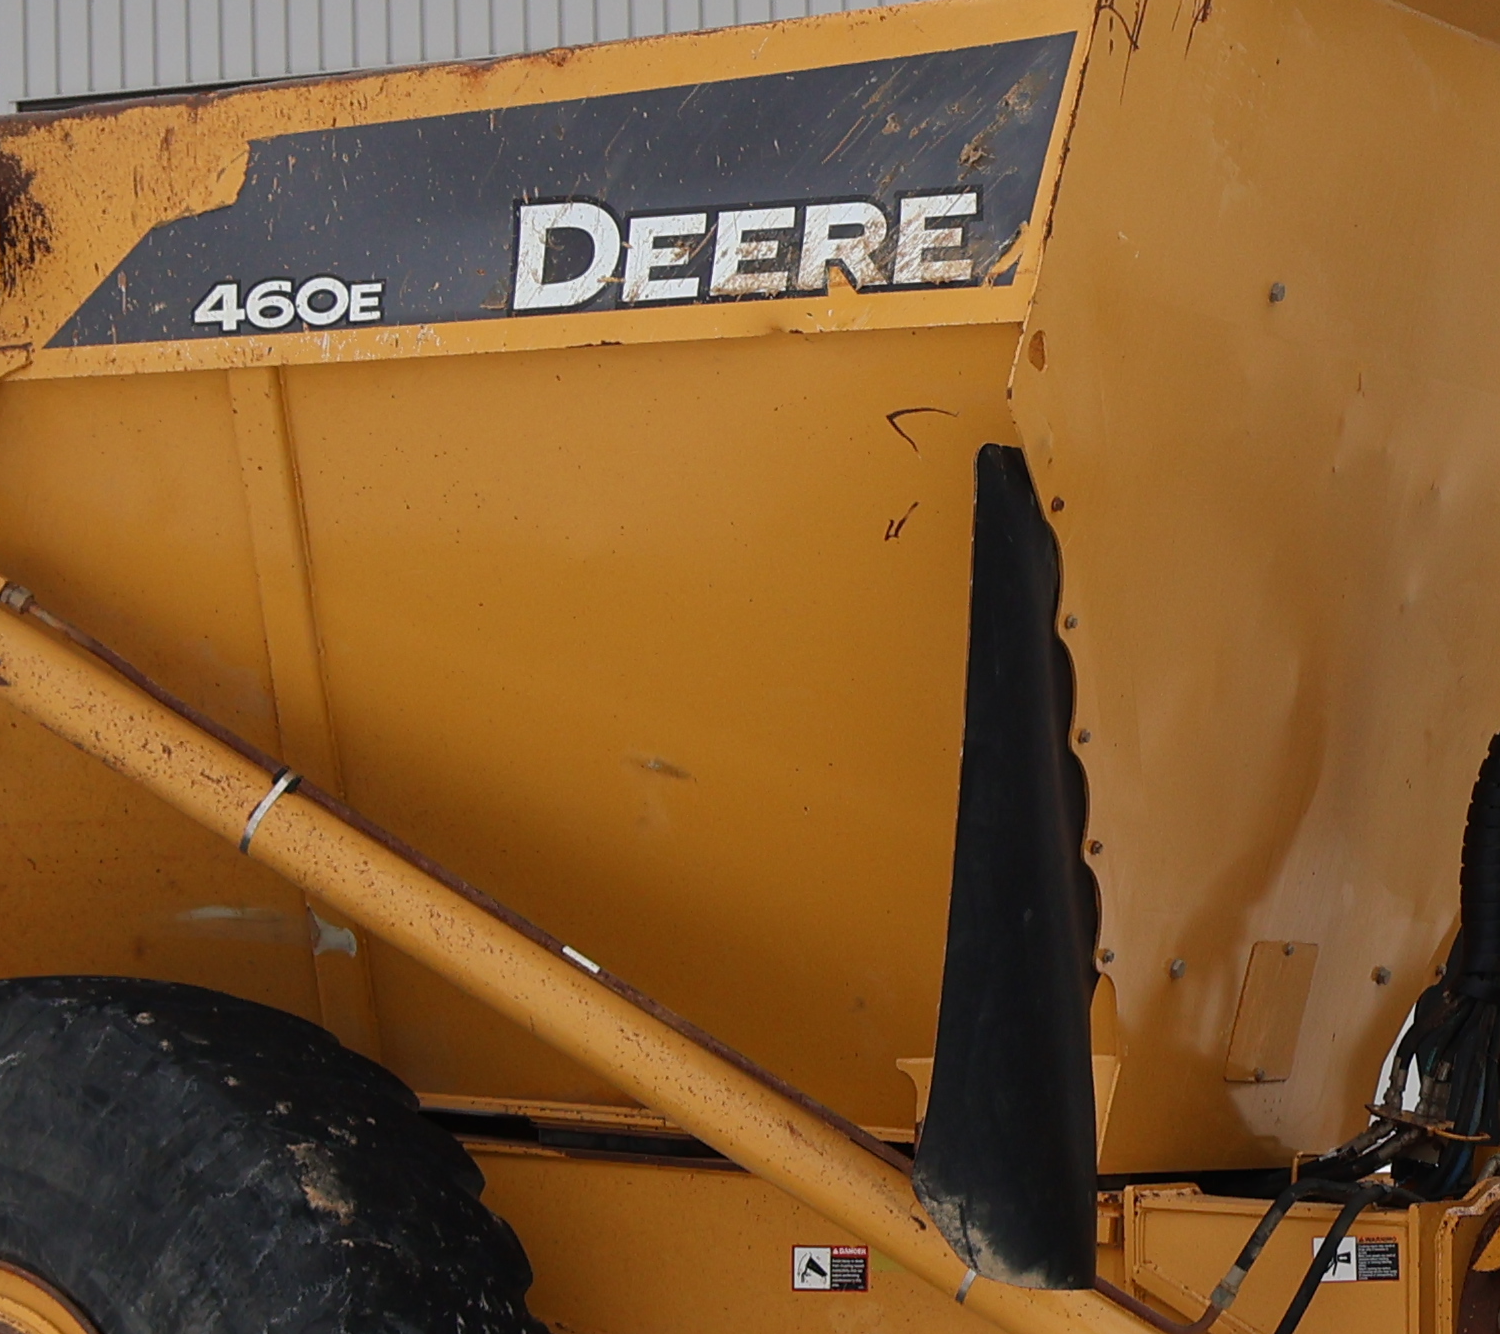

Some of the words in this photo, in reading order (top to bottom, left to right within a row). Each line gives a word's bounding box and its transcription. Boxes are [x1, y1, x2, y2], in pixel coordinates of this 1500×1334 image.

[512, 192, 978, 311] DEERE
[194, 276, 383, 332] 460E
[839, 1247, 866, 1255] DANGER
